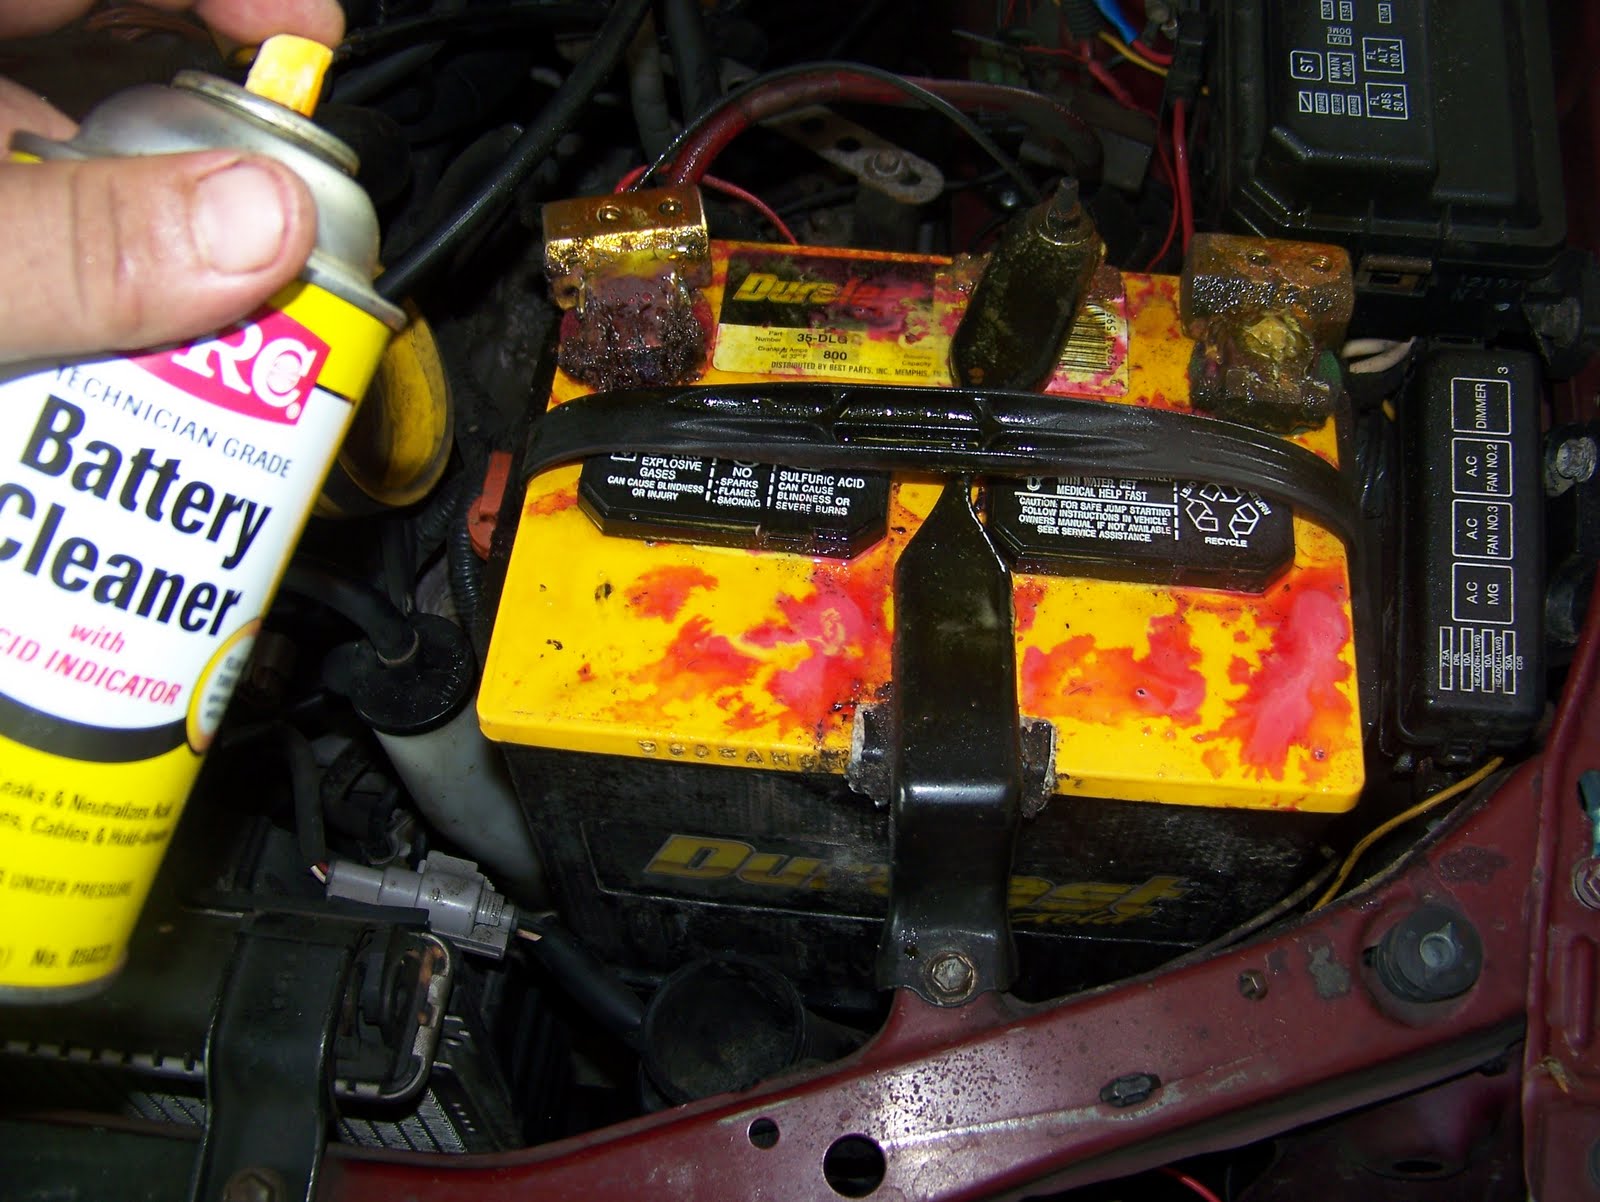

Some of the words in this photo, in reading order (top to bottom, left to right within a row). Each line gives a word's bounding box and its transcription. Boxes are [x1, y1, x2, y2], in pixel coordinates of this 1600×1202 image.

[1327, 27, 1352, 35] DOME
[1367, 51, 1377, 60] FL
[1378, 47, 1388, 64] ALT
[1300, 57, 1314, 73] ST
[1331, 57, 1340, 79] MAIN
[1343, 61, 1352, 77] 40A
[1370, 96, 1380, 105] FL
[1381, 92, 1392, 110] ABS
[823, 350, 848, 361] 800
[172, 325, 317, 410] RC
[771, 361, 816, 370] DISTRIBUTED
[818, 362, 827, 370] BY
[829, 363, 847, 372] BEST
[1497, 366, 1508, 374] 3
[1475, 383, 1487, 429] DIMMER
[223, 437, 293, 478] GRADE
[1486, 443, 1498, 468] NO.2
[640, 467, 676, 479] GASES
[641, 457, 702, 472] EXPLOSIVE
[732, 466, 752, 478] NO
[1465, 455, 1478, 478] A.C
[18, 394, 272, 571] Battery
[607, 475, 625, 485] CAN
[627, 477, 655, 488] CAUSE
[657, 481, 704, 494] BLINDNESS
[720, 477, 759, 489] SPARKS
[778, 482, 799, 492] CAN
[802, 484, 834, 495] CAUSE
[779, 471, 835, 486] SULFURIC
[837, 477, 865, 489] ACID
[1486, 472, 1498, 492] FAN
[632, 488, 645, 497] OR
[647, 490, 679, 500] INJURY
[718, 487, 756, 498] FLAMES
[777, 492, 831, 504] BLINDNESS
[835, 497, 851, 507] OR
[1057, 485, 1096, 498] MEDICAL
[1099, 488, 1122, 500] HELP
[1125, 491, 1147, 502] FAST
[717, 496, 761, 508] SMOKING
[775, 501, 811, 512] SEVERE
[815, 504, 848, 515] BURNS
[1019, 496, 1058, 508] CAUTION:
[1061, 500, 1078, 509] FOR
[1080, 501, 1102, 512] SAFE
[1104, 503, 1127, 513] JUMP
[1129, 505, 1171, 517] STARTING
[1022, 507, 1057, 517] FOLLOW
[1059, 509, 1120, 522] INSTRUCTIONS
[1122, 514, 1131, 523] IN
[1133, 515, 1168, 525] VEHICLE
[1487, 505, 1499, 530] NO.3
[1018, 515, 1055, 525] OWNERS
[1097, 520, 1105, 529] IF
[1107, 521, 1126, 531] NOT
[1128, 523, 1172, 535] AVAILABLE
[1037, 525, 1059, 535] SEEK
[1062, 527, 1097, 538] SERVICE
[1466, 517, 1478, 540] A.C
[1204, 536, 1248, 548] RECYCLE
[1487, 534, 1499, 555] FAN
[0, 482, 243, 637] Cleaner
[1466, 581, 1478, 604] A.C
[1487, 583, 1499, 605] MG
[70, 624, 126, 654] with
[0, 628, 40, 663] CID
[45, 650, 182, 706] INDICATOR
[1463, 652, 1471, 666] 10A
[1484, 653, 1492, 668] 10A
[1505, 654, 1513, 671] 30A
